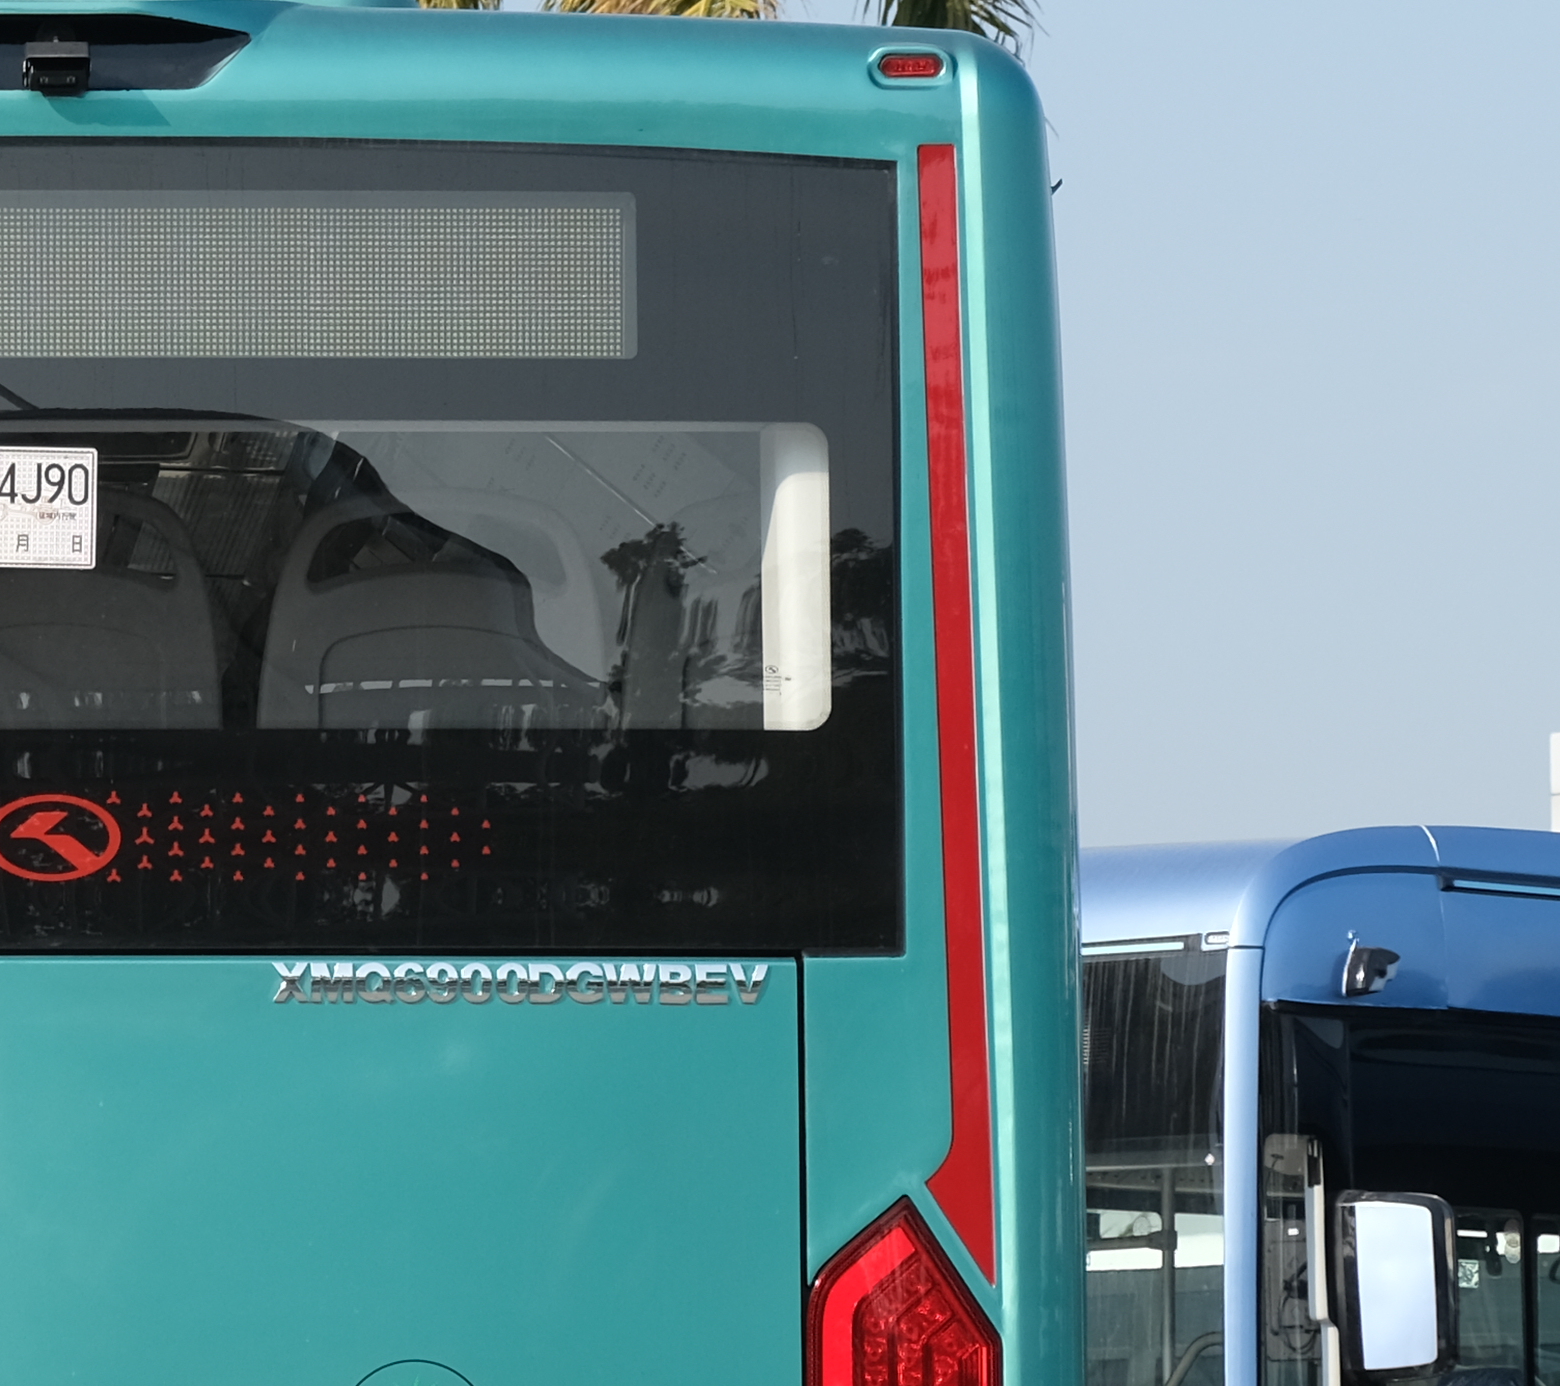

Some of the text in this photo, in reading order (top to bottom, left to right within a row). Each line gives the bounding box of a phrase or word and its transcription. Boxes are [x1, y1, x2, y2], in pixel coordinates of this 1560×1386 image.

[16, 534, 29, 552] 月
[72, 535, 82, 553] 日
[272, 961, 769, 1005] XMQ6900DGWBEV
